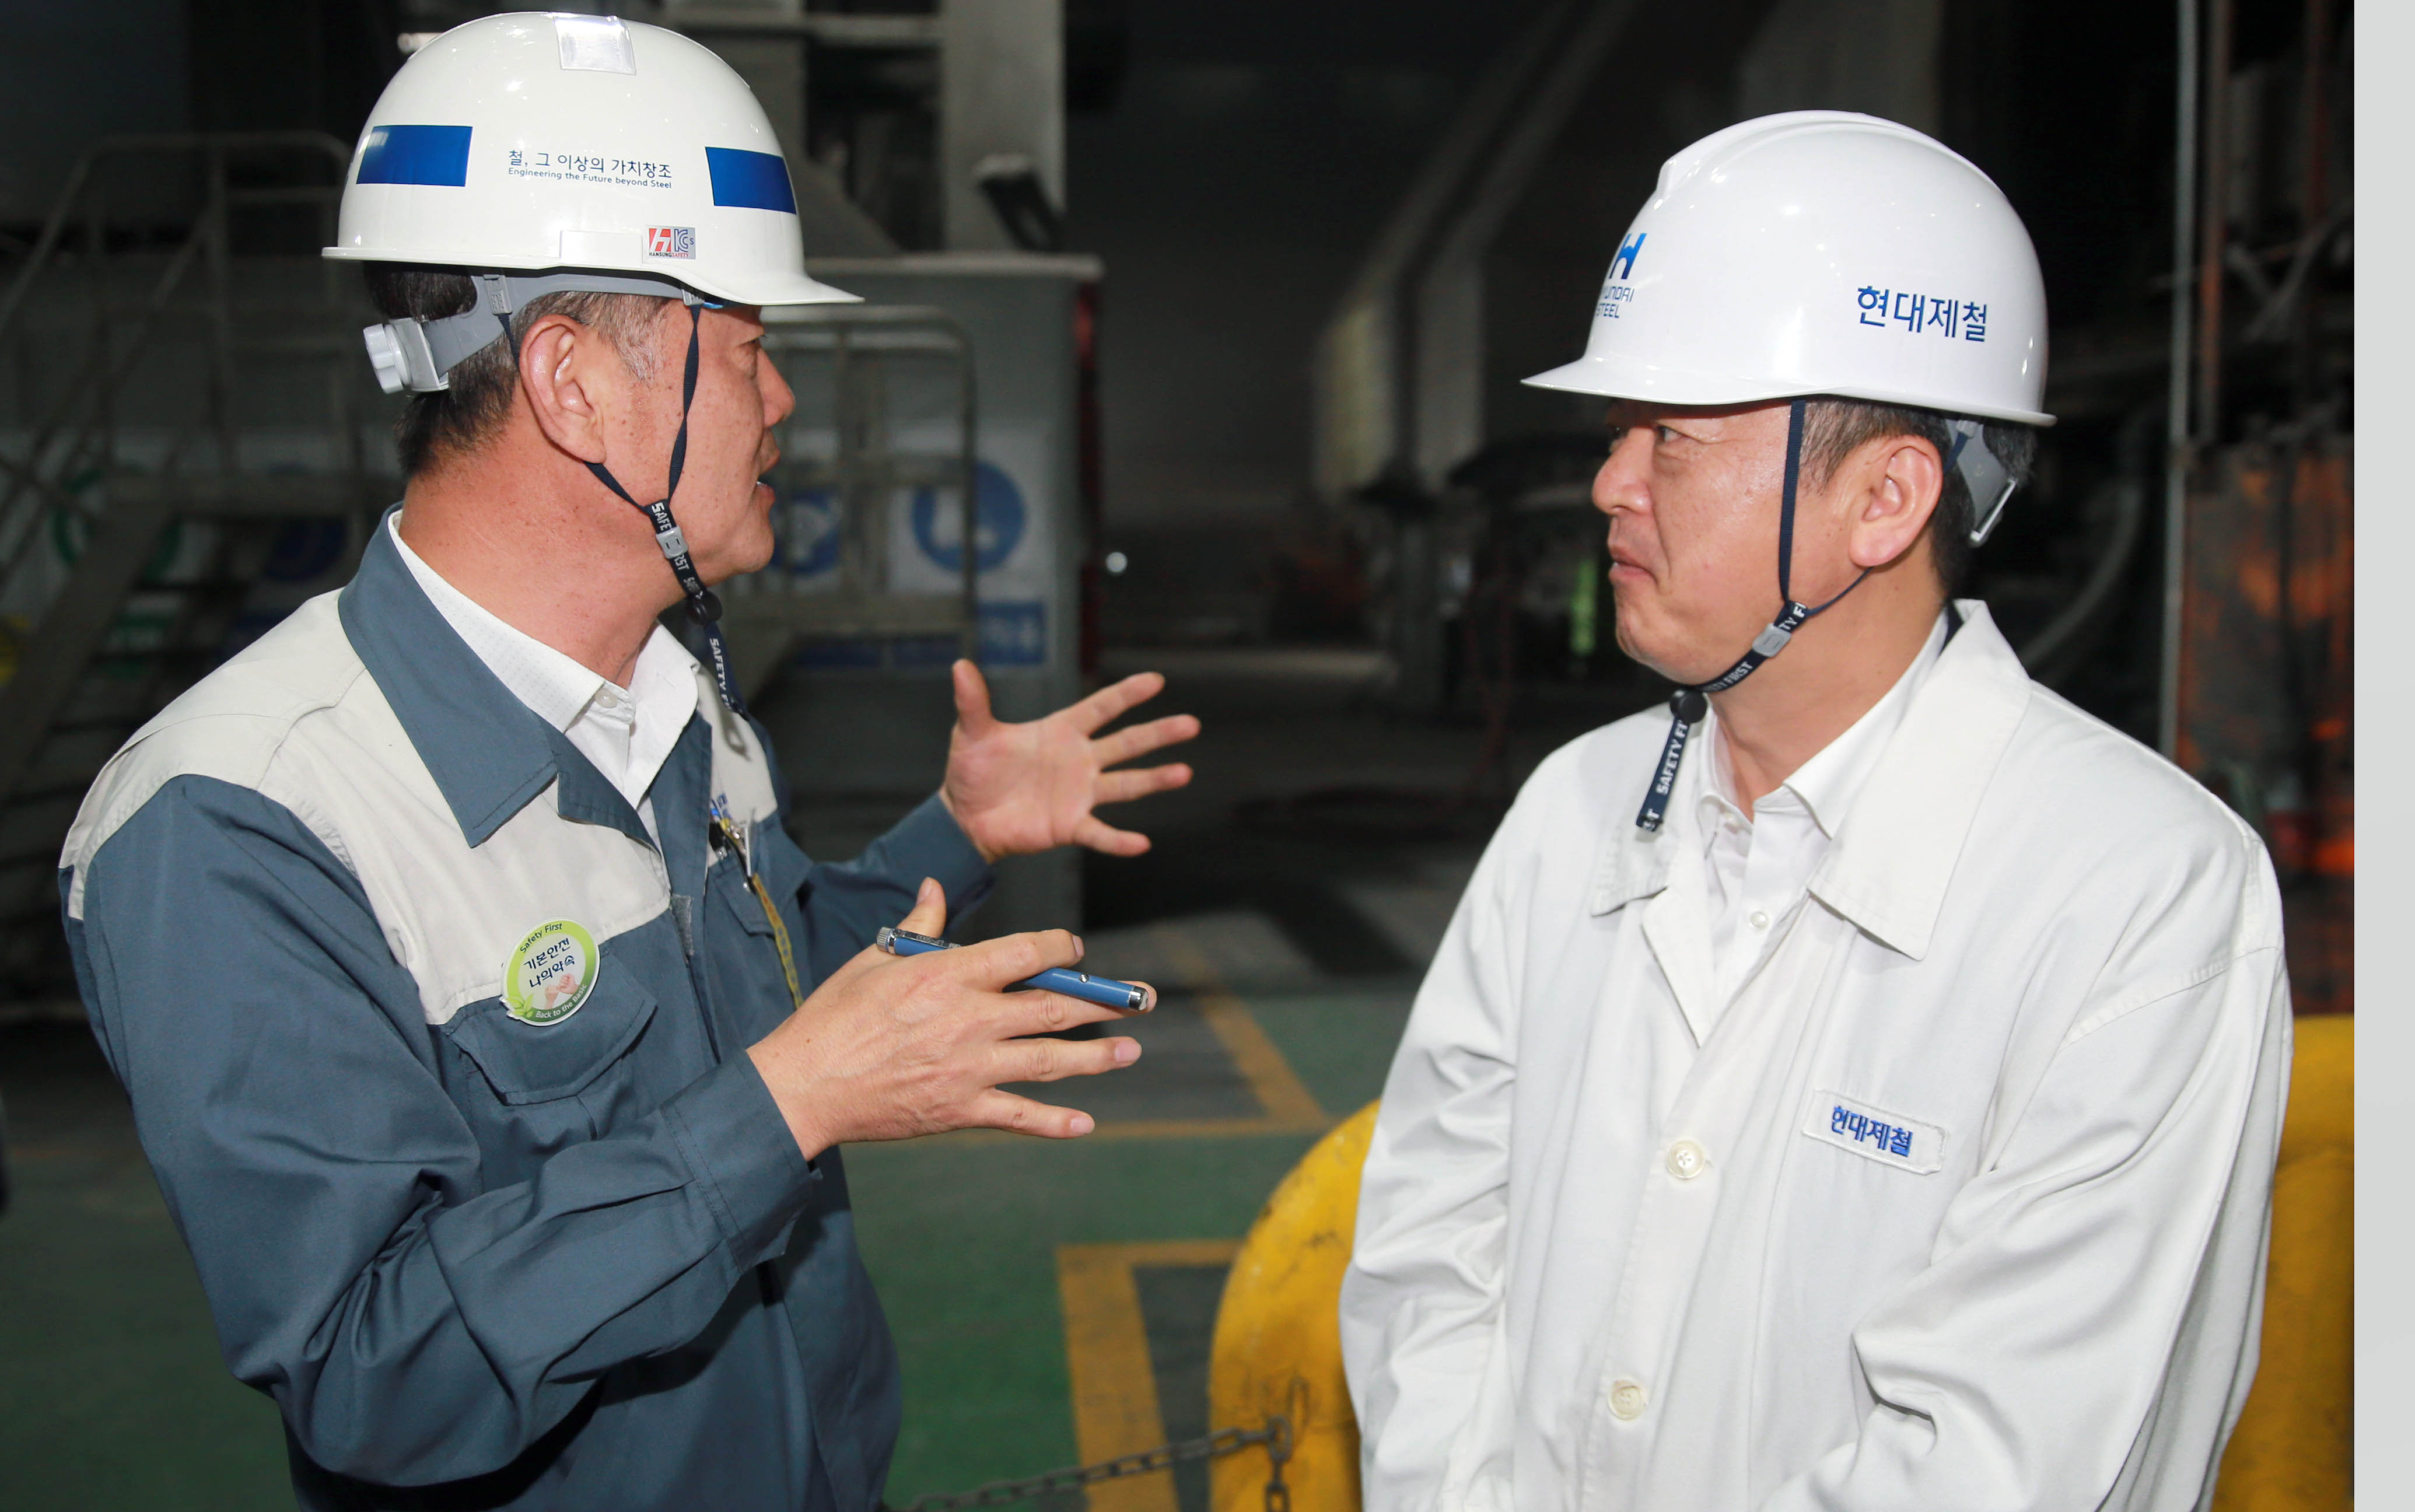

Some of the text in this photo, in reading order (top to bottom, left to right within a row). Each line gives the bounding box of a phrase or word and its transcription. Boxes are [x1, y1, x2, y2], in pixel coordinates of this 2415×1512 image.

[508, 167, 562, 180] Engineering
[583, 174, 612, 183] Future
[615, 177, 648, 186] beyond
[651, 180, 671, 188] Steel
[509, 150, 672, 178] 철, 그 이상의 가치창조
[1857, 285, 1987, 342] 현대제철
[651, 502, 672, 531] SAFE
[709, 638, 726, 690] SAFETY
[1656, 738, 1682, 795] SAFETY
[520, 923, 562, 953] Safety First
[523, 938, 570, 970] 기본안전
[529, 955, 575, 987] 나의약속
[536, 1010, 552, 1019] Back
[562, 1002, 573, 1012] the
[1832, 1105, 1913, 1157] 현대제철
